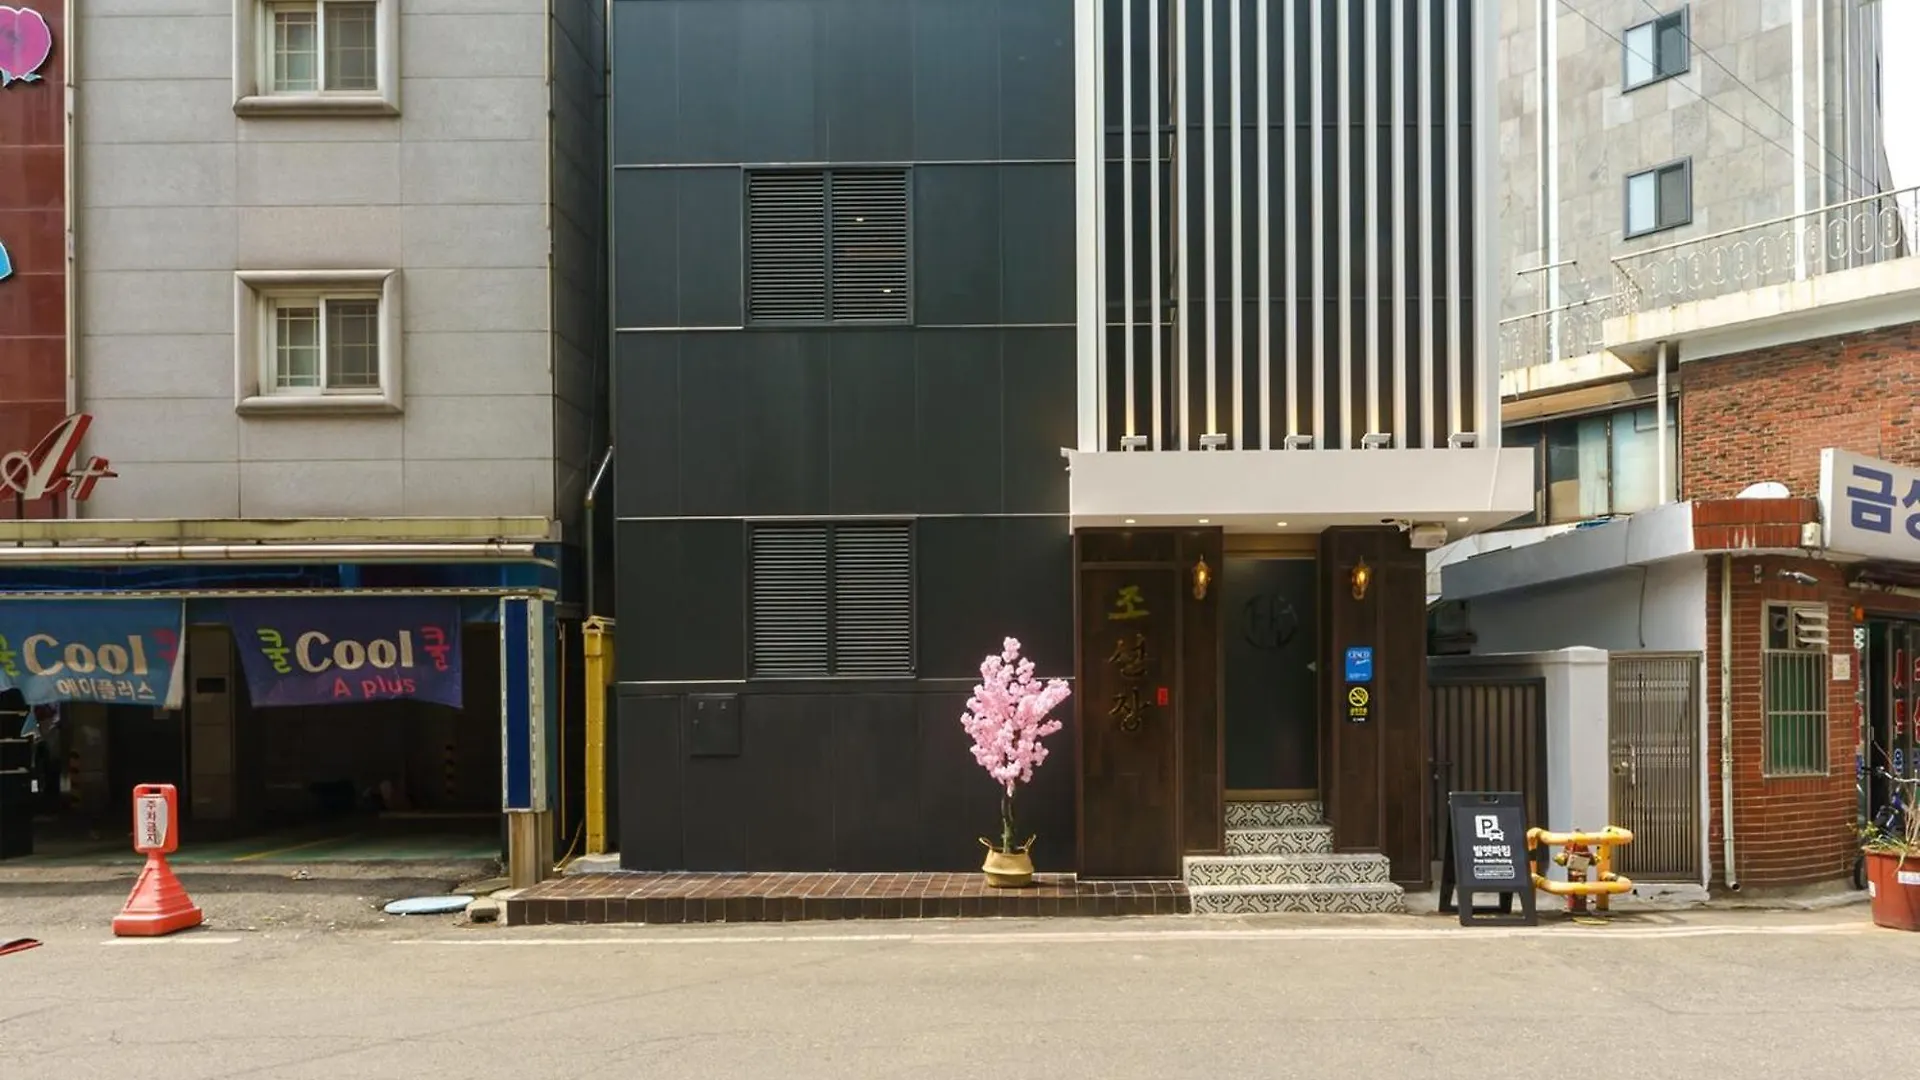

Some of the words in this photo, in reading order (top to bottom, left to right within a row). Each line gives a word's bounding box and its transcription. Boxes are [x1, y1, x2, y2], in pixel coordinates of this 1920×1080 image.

[23, 633, 148, 676] Cool
[256, 628, 293, 674] 쿨
[295, 630, 414, 673] Cool
[333, 676, 352, 698] A
[362, 675, 416, 699] plus
